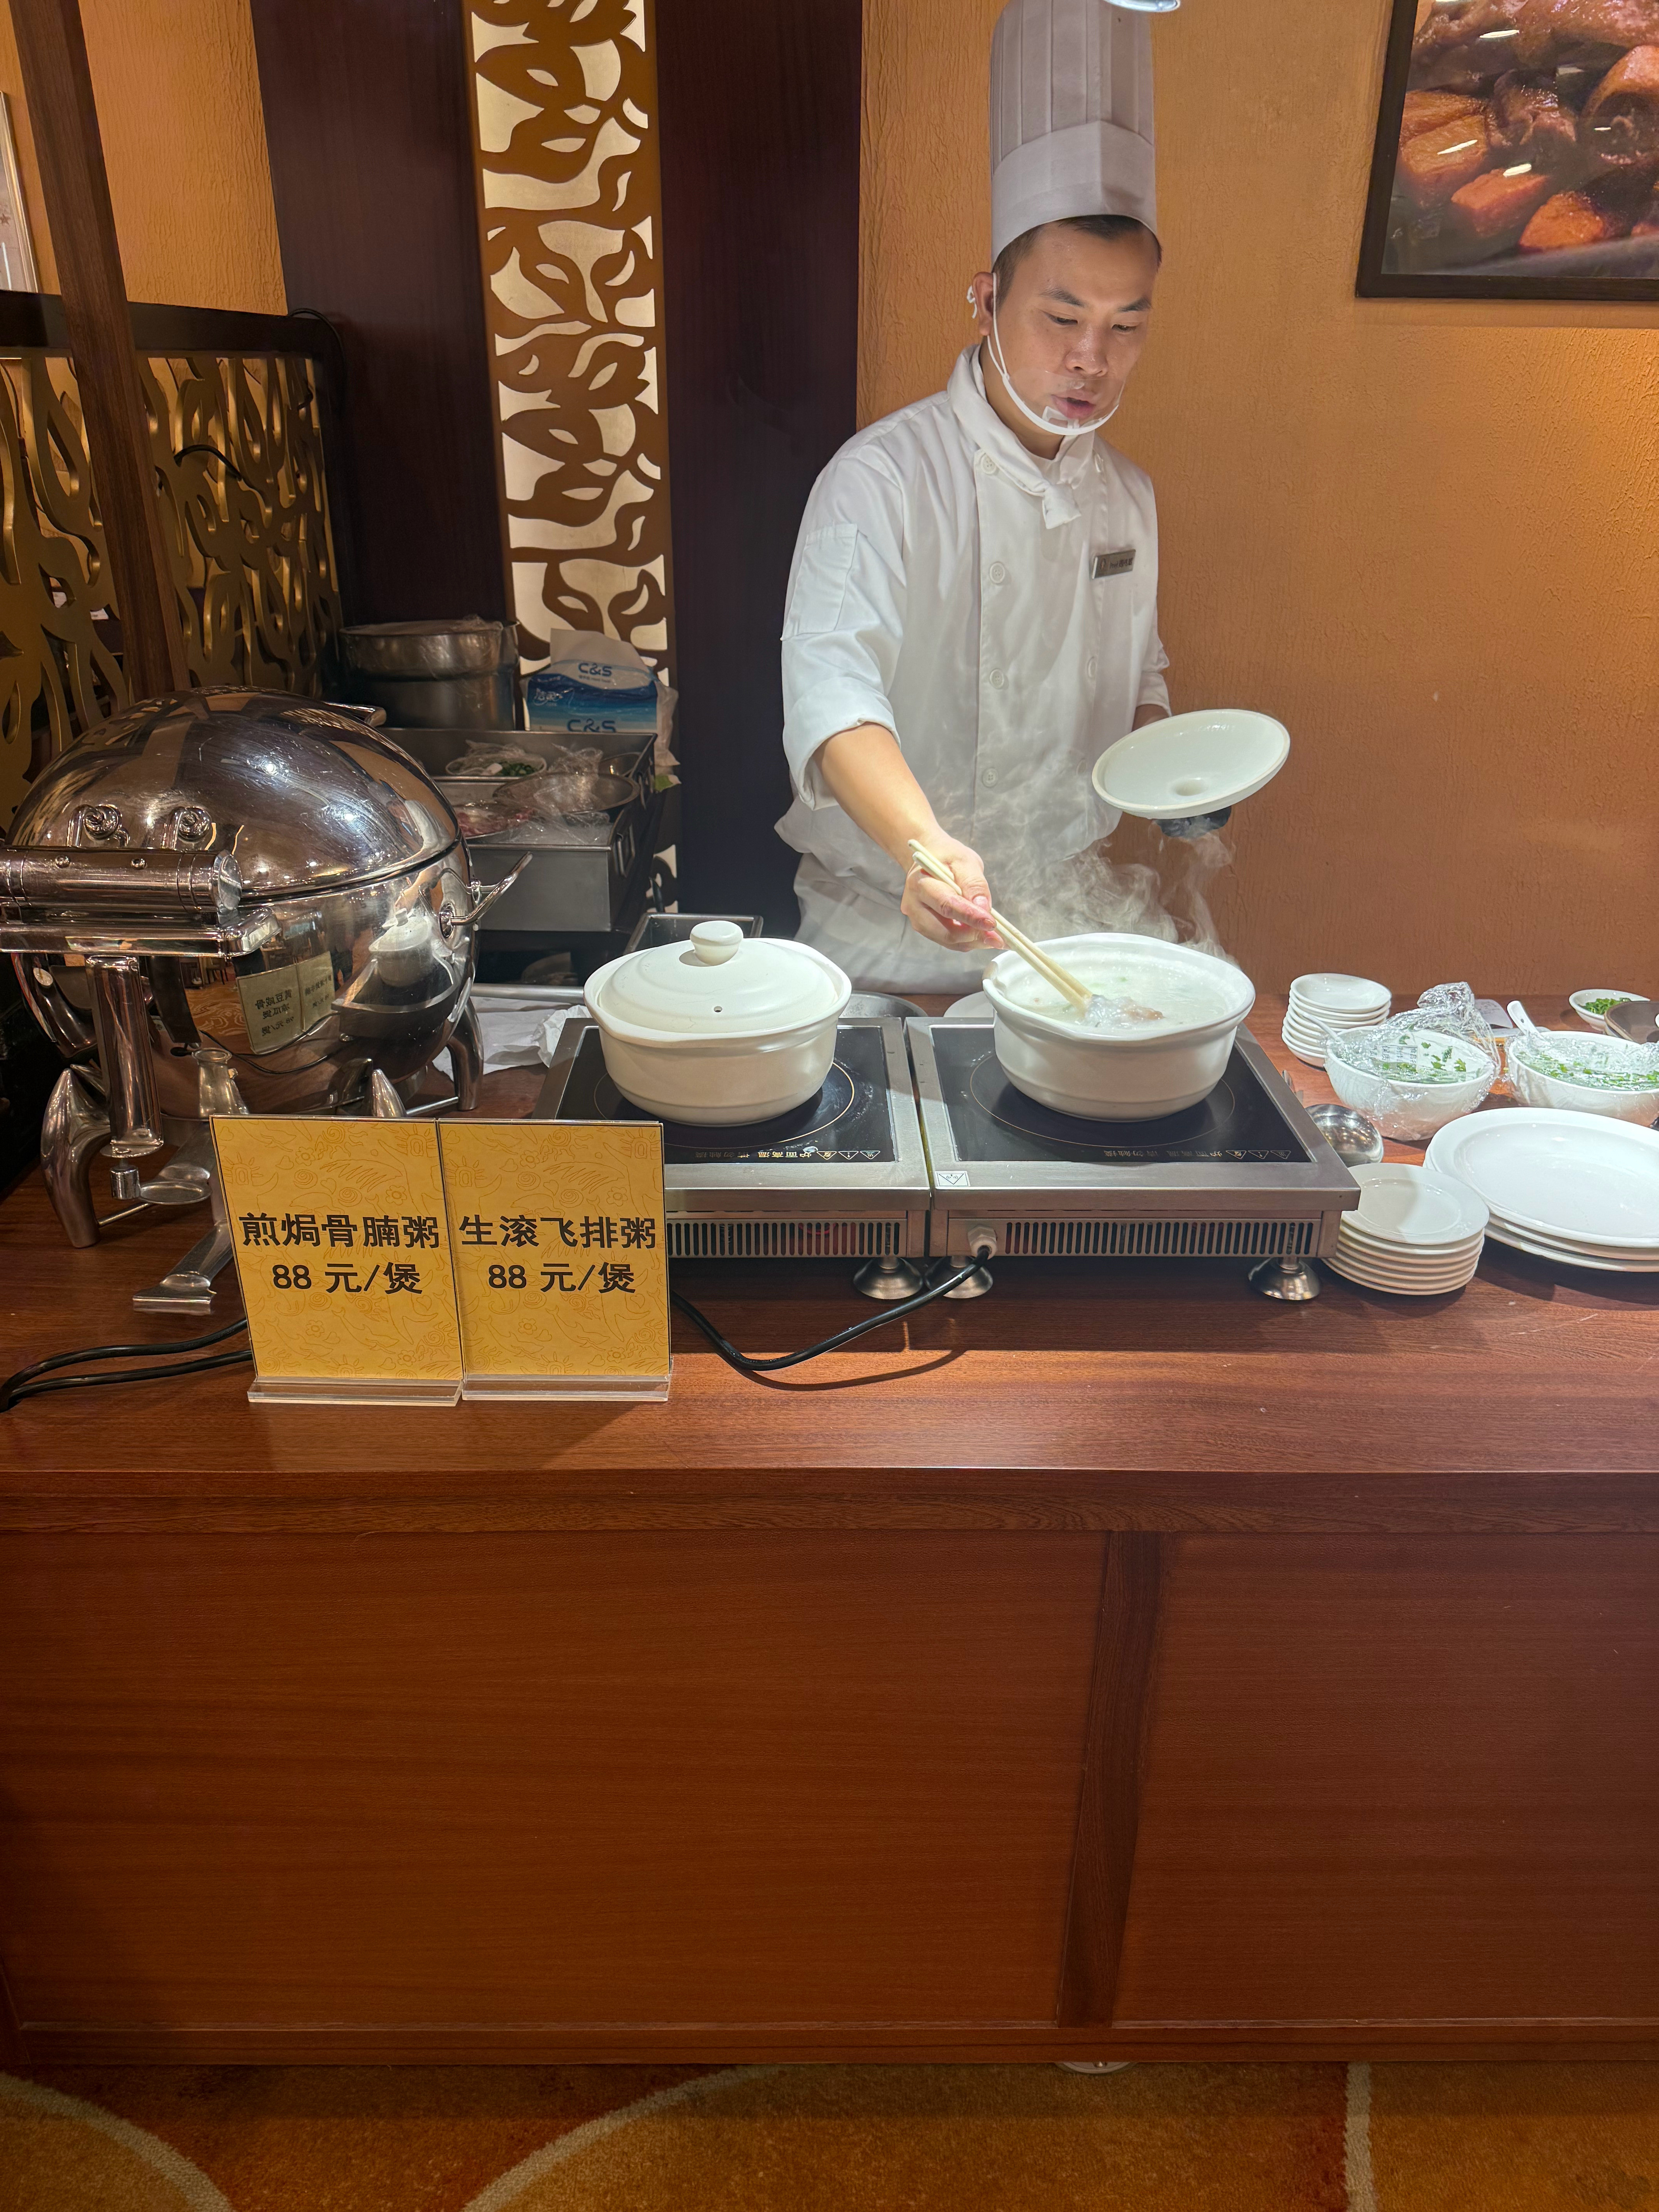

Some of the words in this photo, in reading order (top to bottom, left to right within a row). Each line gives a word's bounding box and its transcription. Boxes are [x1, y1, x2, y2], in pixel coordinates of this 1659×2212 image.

[578, 662, 612, 677] C&S
[567, 719, 616, 733] C&S
[239, 1212, 439, 1249] 煎焗骨腩粥
[459, 1214, 656, 1249] 生滚飞排粥
[272, 1264, 312, 1290] 88
[325, 1262, 422, 1294] 元/煲
[488, 1264, 527, 1289] 88
[540, 1262, 636, 1293] 元/煲
